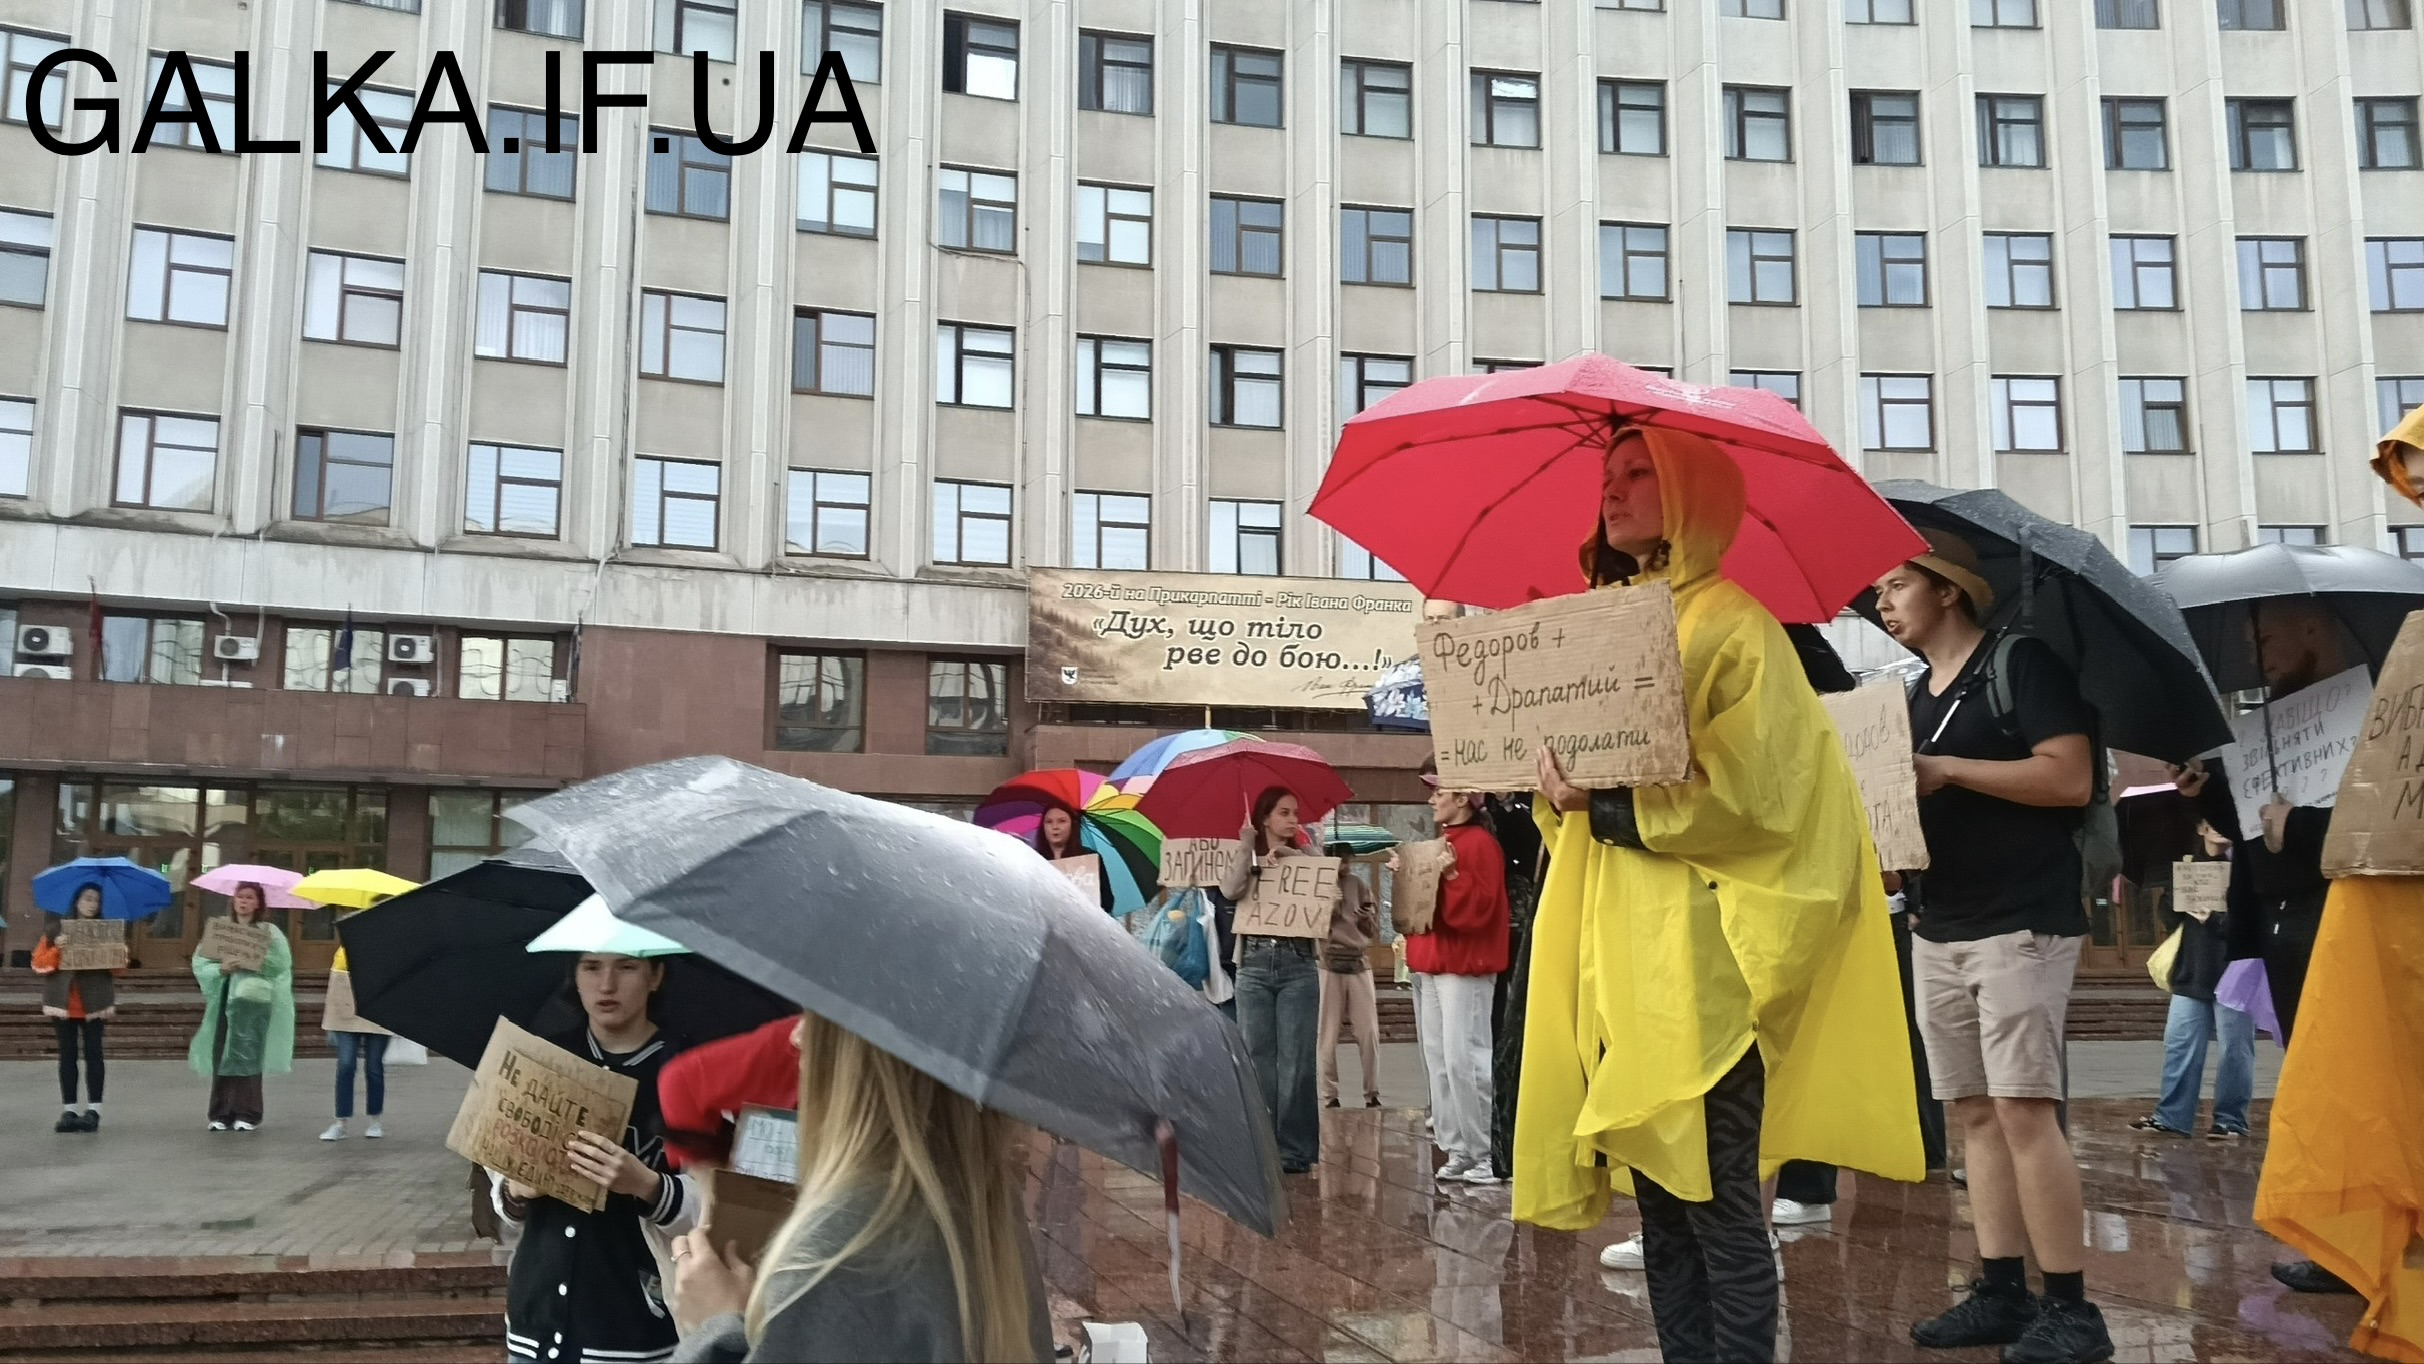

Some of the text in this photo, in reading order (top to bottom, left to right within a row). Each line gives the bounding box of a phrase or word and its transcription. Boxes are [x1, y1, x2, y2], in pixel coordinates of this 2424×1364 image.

[1062, 583, 1121, 599] 2026-й
[1125, 588, 1145, 600] на
[1150, 587, 1262, 607] Прикарпатті
[1276, 592, 1303, 608] Рік
[1305, 593, 1348, 610] Івана
[1352, 595, 1412, 614] Франка
[1092, 611, 1322, 640] «Дух, що тіло
[1163, 641, 1392, 671] рве до бою...!»
[1433, 621, 1540, 686] Федоров
[1488, 665, 1621, 731] Драпатий
[2242, 720, 2324, 772] ЗВІЬНЯТИ
[1257, 865, 1336, 899] FREE
[1246, 902, 1323, 928] AZOV
